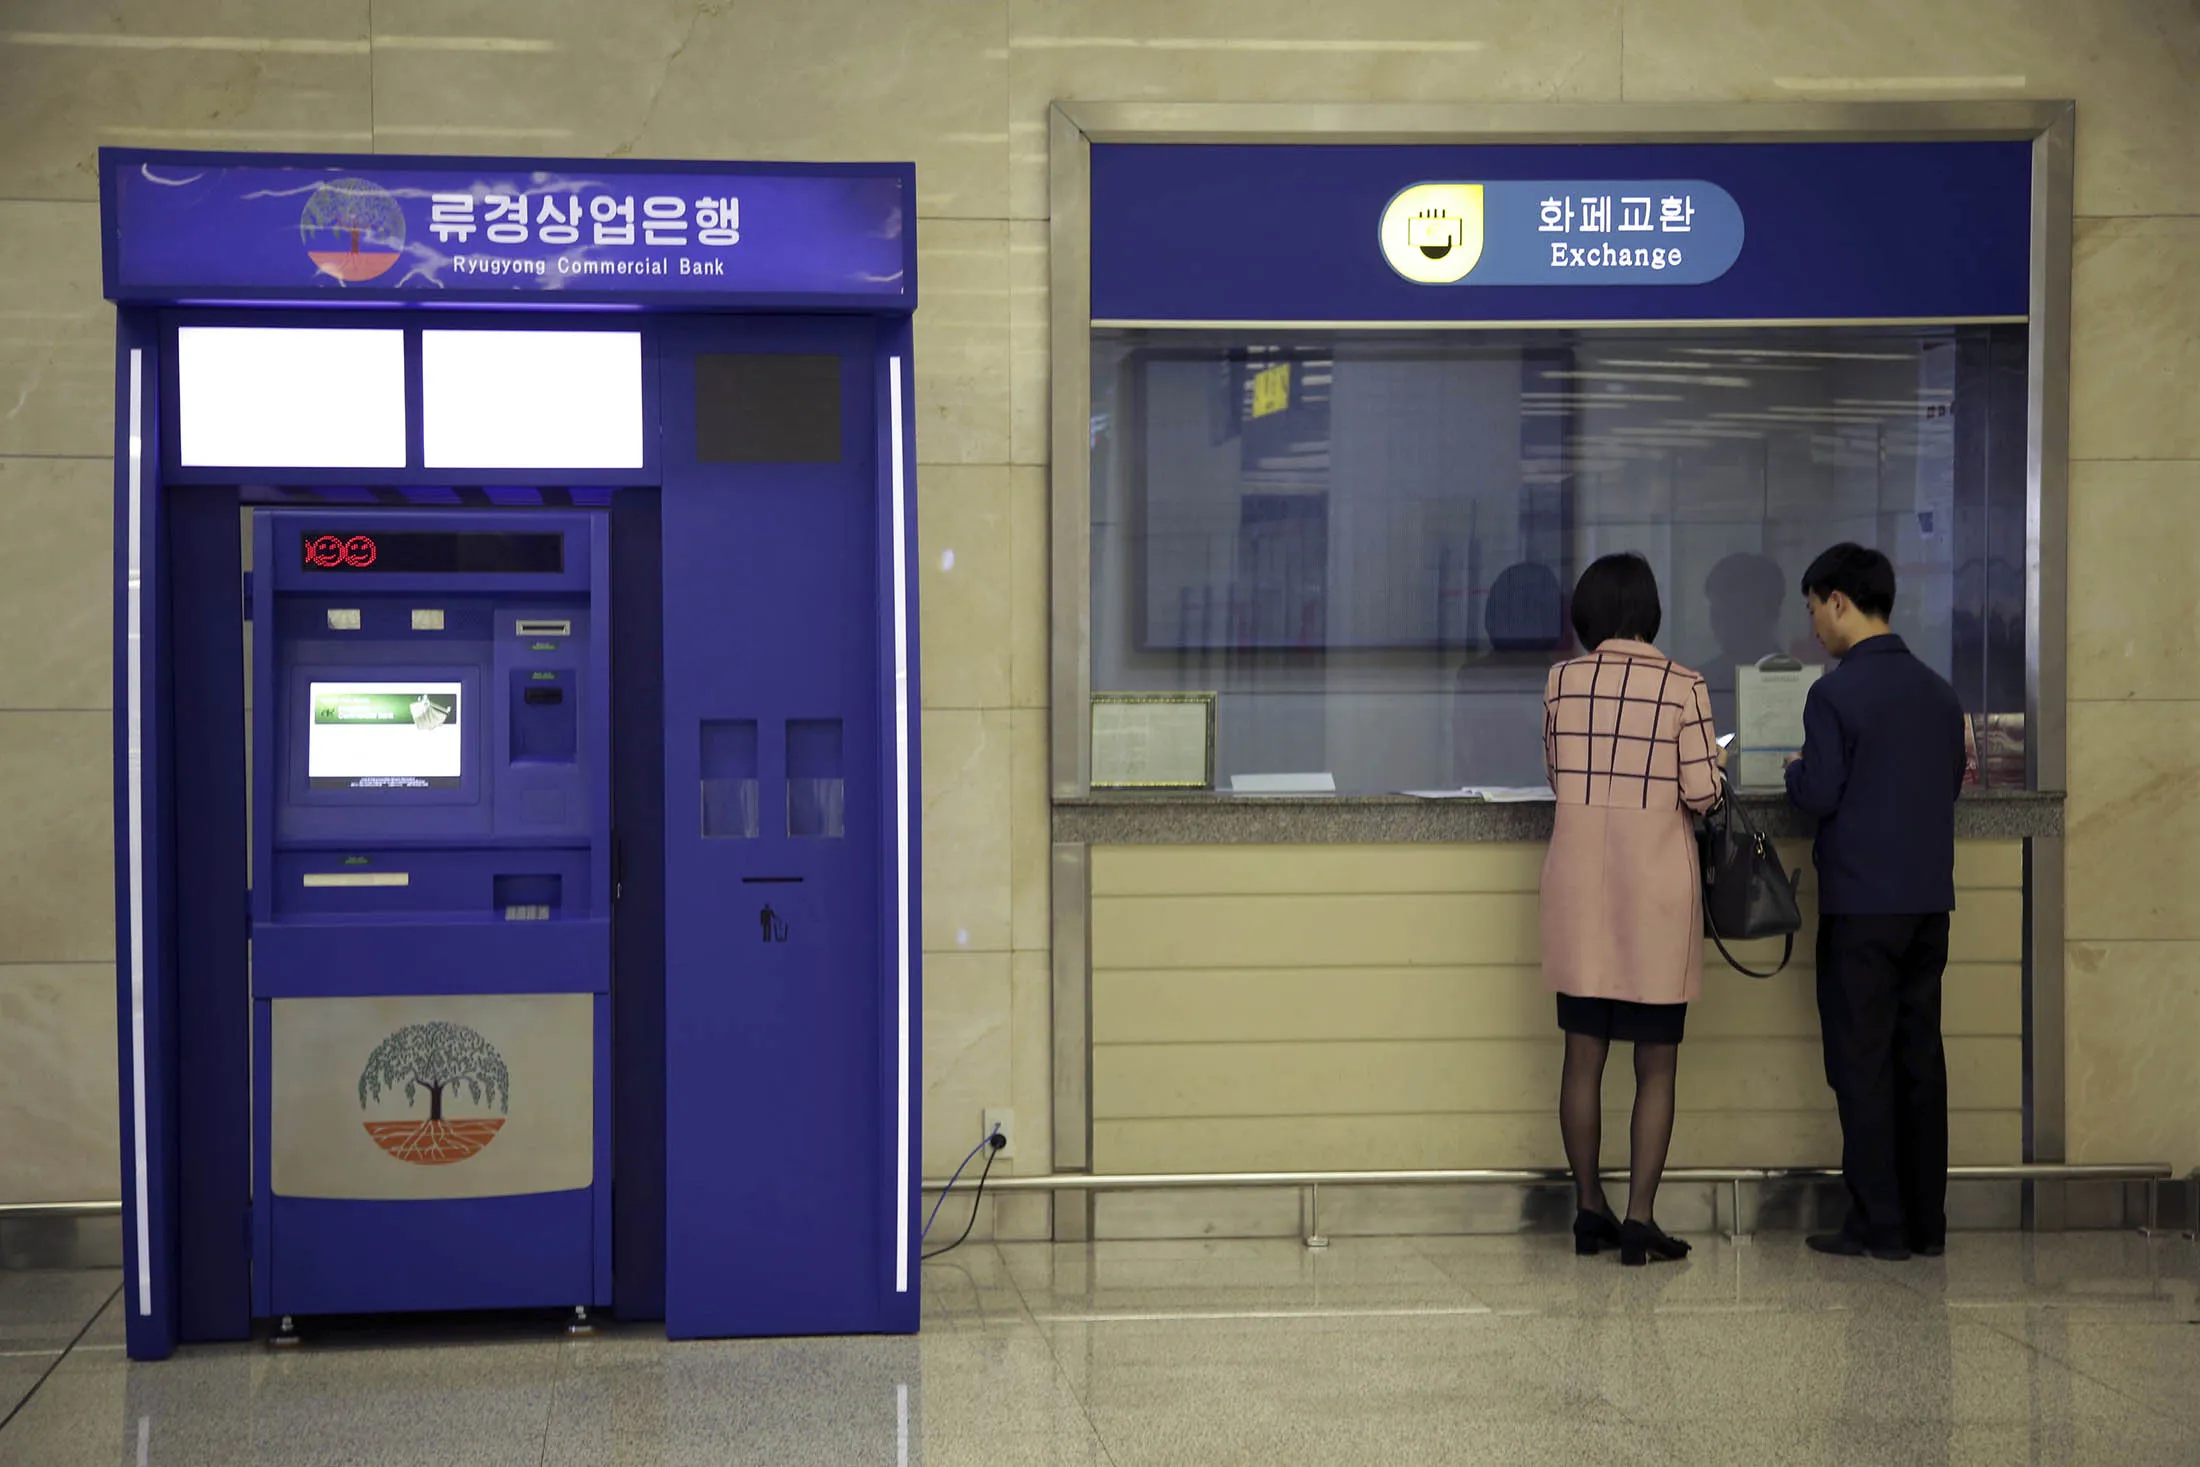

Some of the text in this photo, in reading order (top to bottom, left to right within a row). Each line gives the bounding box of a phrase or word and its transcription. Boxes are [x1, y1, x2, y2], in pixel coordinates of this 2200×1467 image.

[429, 194, 740, 246] 류경상업은행
[1538, 195, 1695, 233] 화페교환
[453, 256, 724, 275] Ryugyong Commercial Bank
[1550, 242, 1682, 270] Exchange
